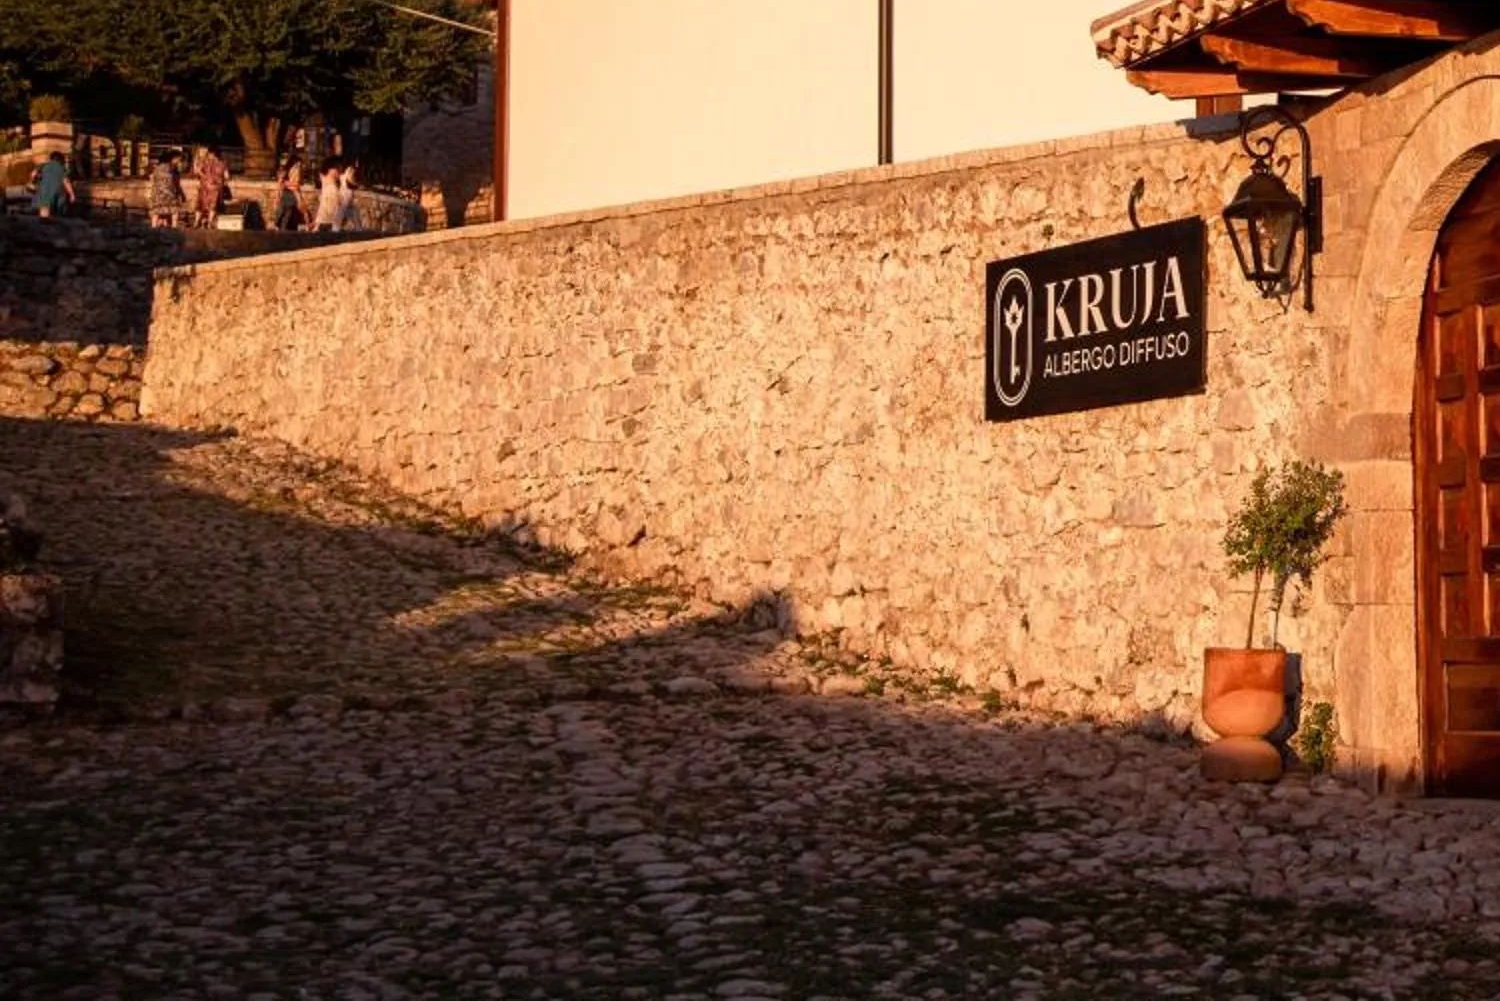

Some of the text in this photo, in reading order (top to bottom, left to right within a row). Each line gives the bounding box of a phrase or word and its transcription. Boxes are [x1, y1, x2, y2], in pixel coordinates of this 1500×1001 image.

[1044, 255, 1191, 342] KRUJA
[1043, 331, 1190, 378] ALBERGO DIFFUSO
